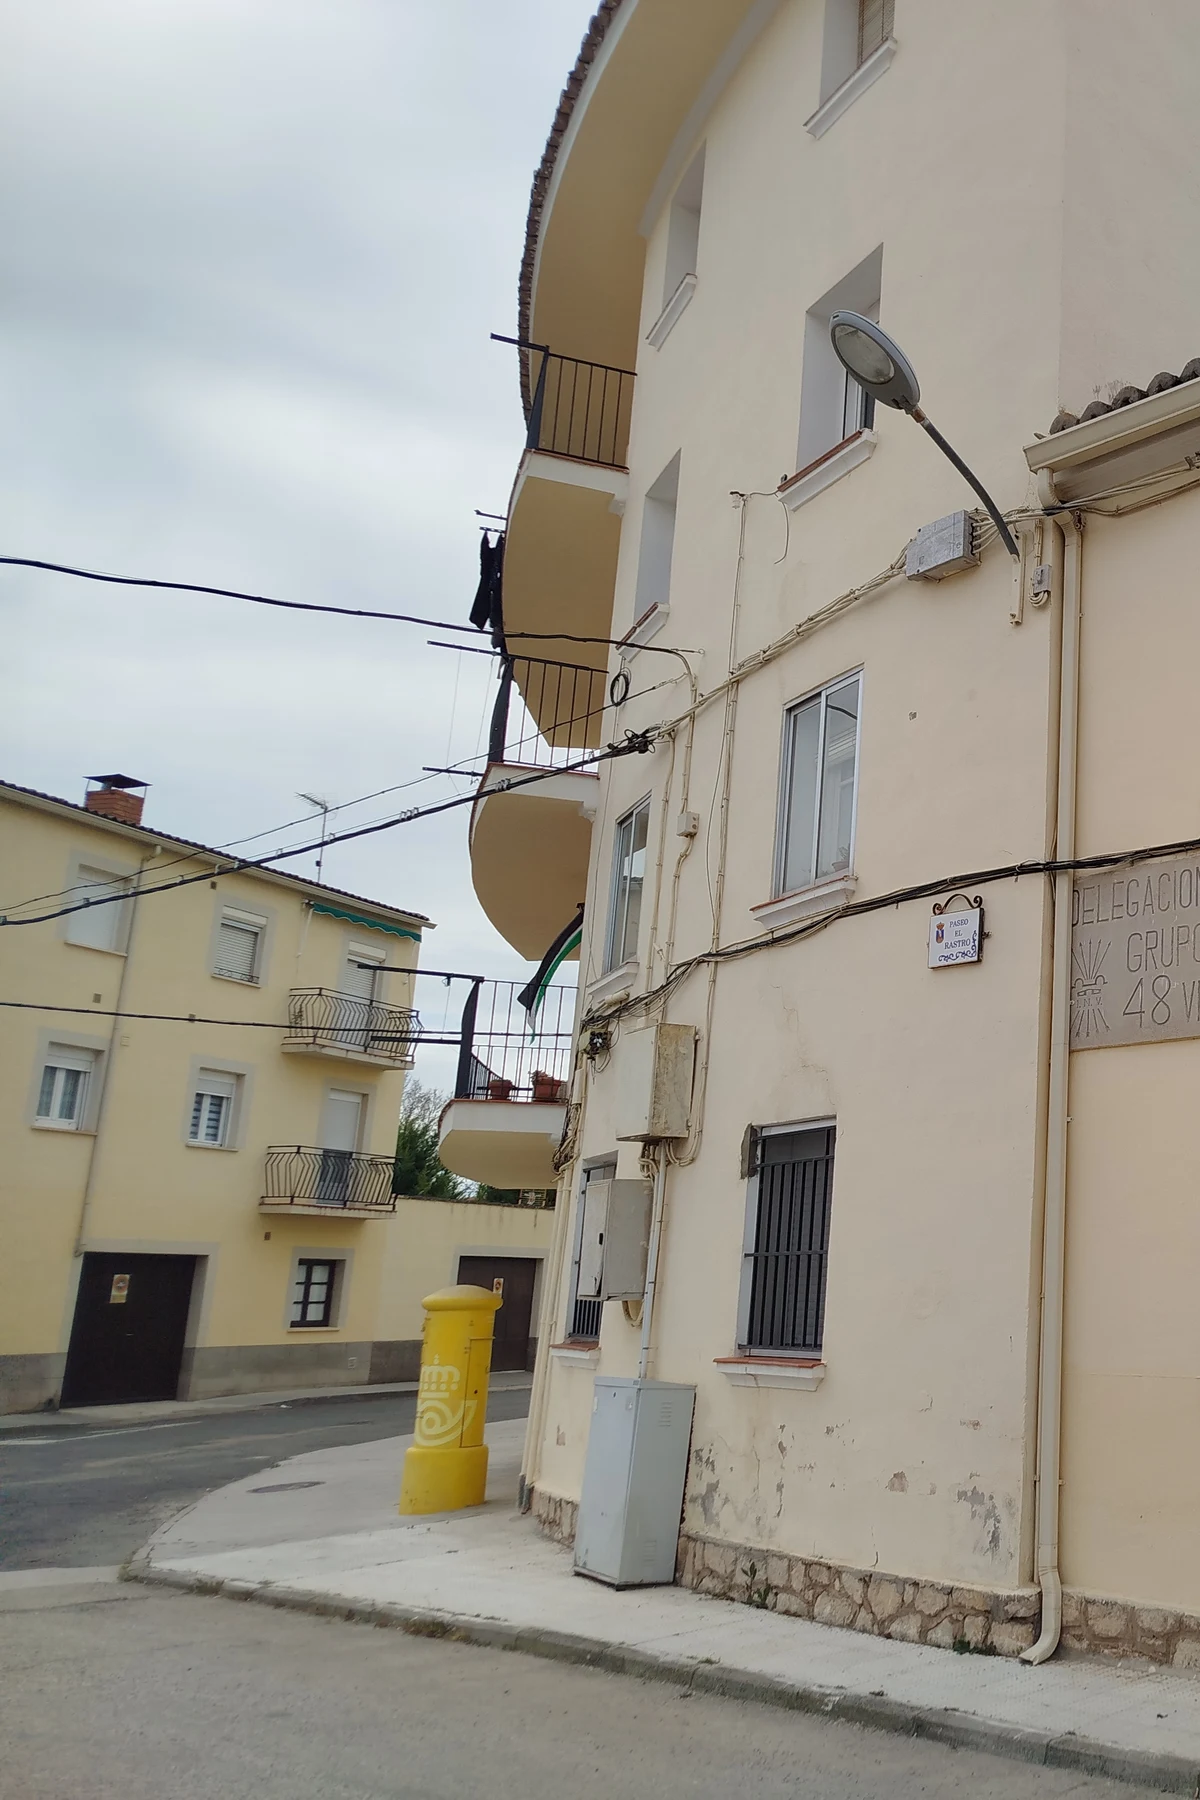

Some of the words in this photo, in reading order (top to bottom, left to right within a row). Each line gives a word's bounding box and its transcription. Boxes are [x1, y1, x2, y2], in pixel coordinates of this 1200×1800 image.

[949, 919, 969, 928] PASEO
[944, 938, 971, 949] RASTRO
[1122, 974, 1172, 1029] 48
